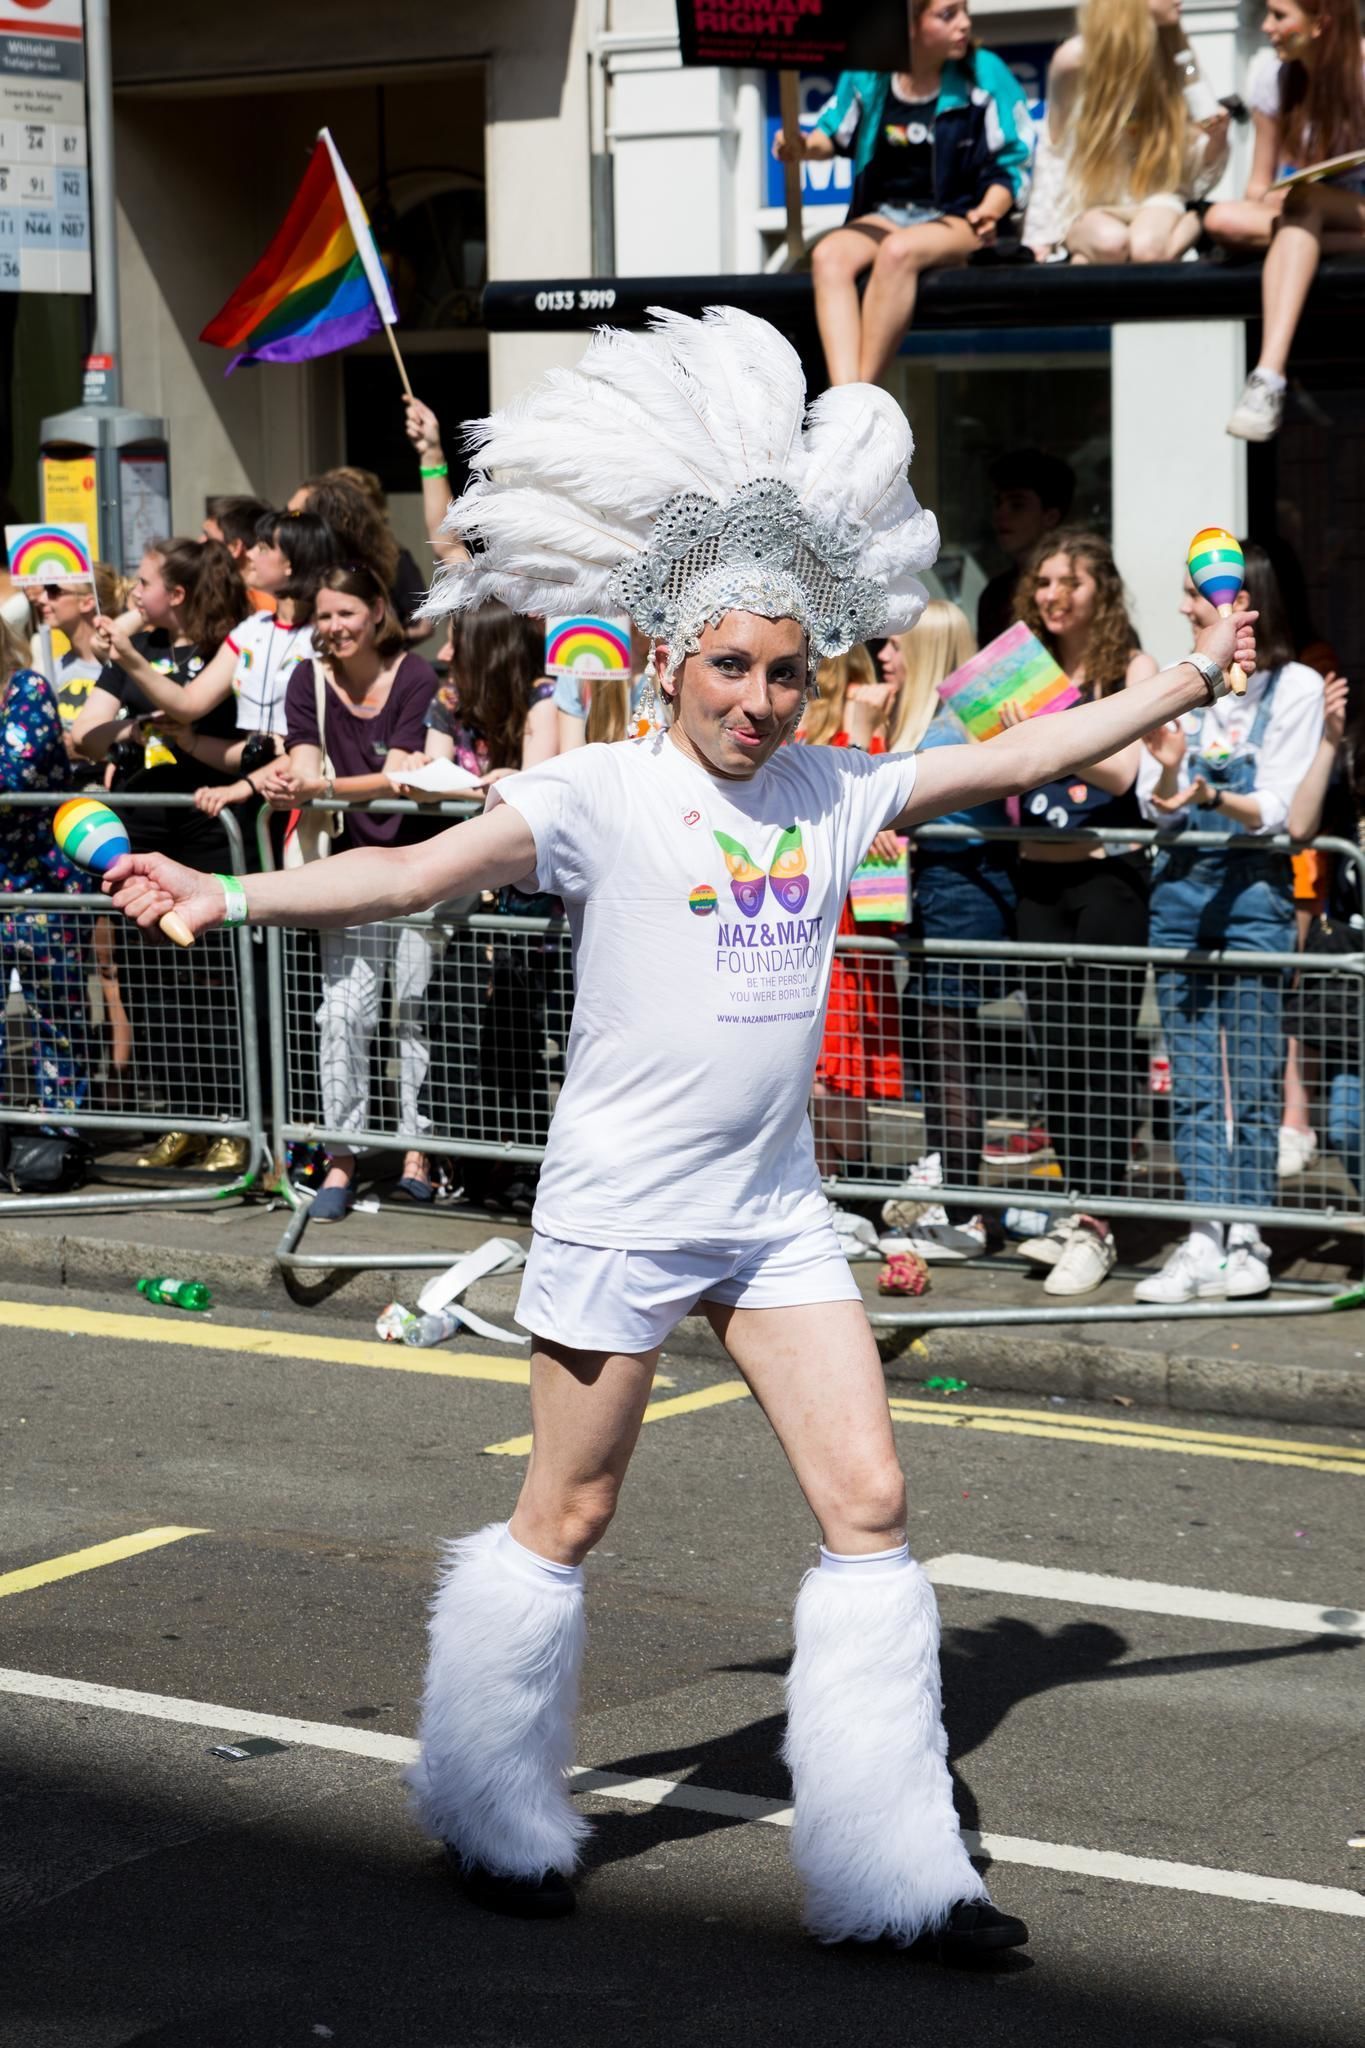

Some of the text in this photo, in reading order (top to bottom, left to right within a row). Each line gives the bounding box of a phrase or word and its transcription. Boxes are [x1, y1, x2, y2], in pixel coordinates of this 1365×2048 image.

[695, 12, 799, 35] RIGHT
[28, 133, 43, 149] 24
[30, 177, 44, 192] 91
[63, 180, 80, 196] N2
[25, 220, 52, 235] N44
[535, 289, 616, 311] 0133 3919
[718, 916, 822, 948] NAZ&MATT
[716, 944, 822, 974] FOUNDATION
[747, 974, 807, 988] BE THE PERSON
[729, 991, 750, 1002] YOU
[753, 990, 777, 1002] WERE
[778, 989, 800, 1001] BORN
[802, 987, 809, 997] TO
